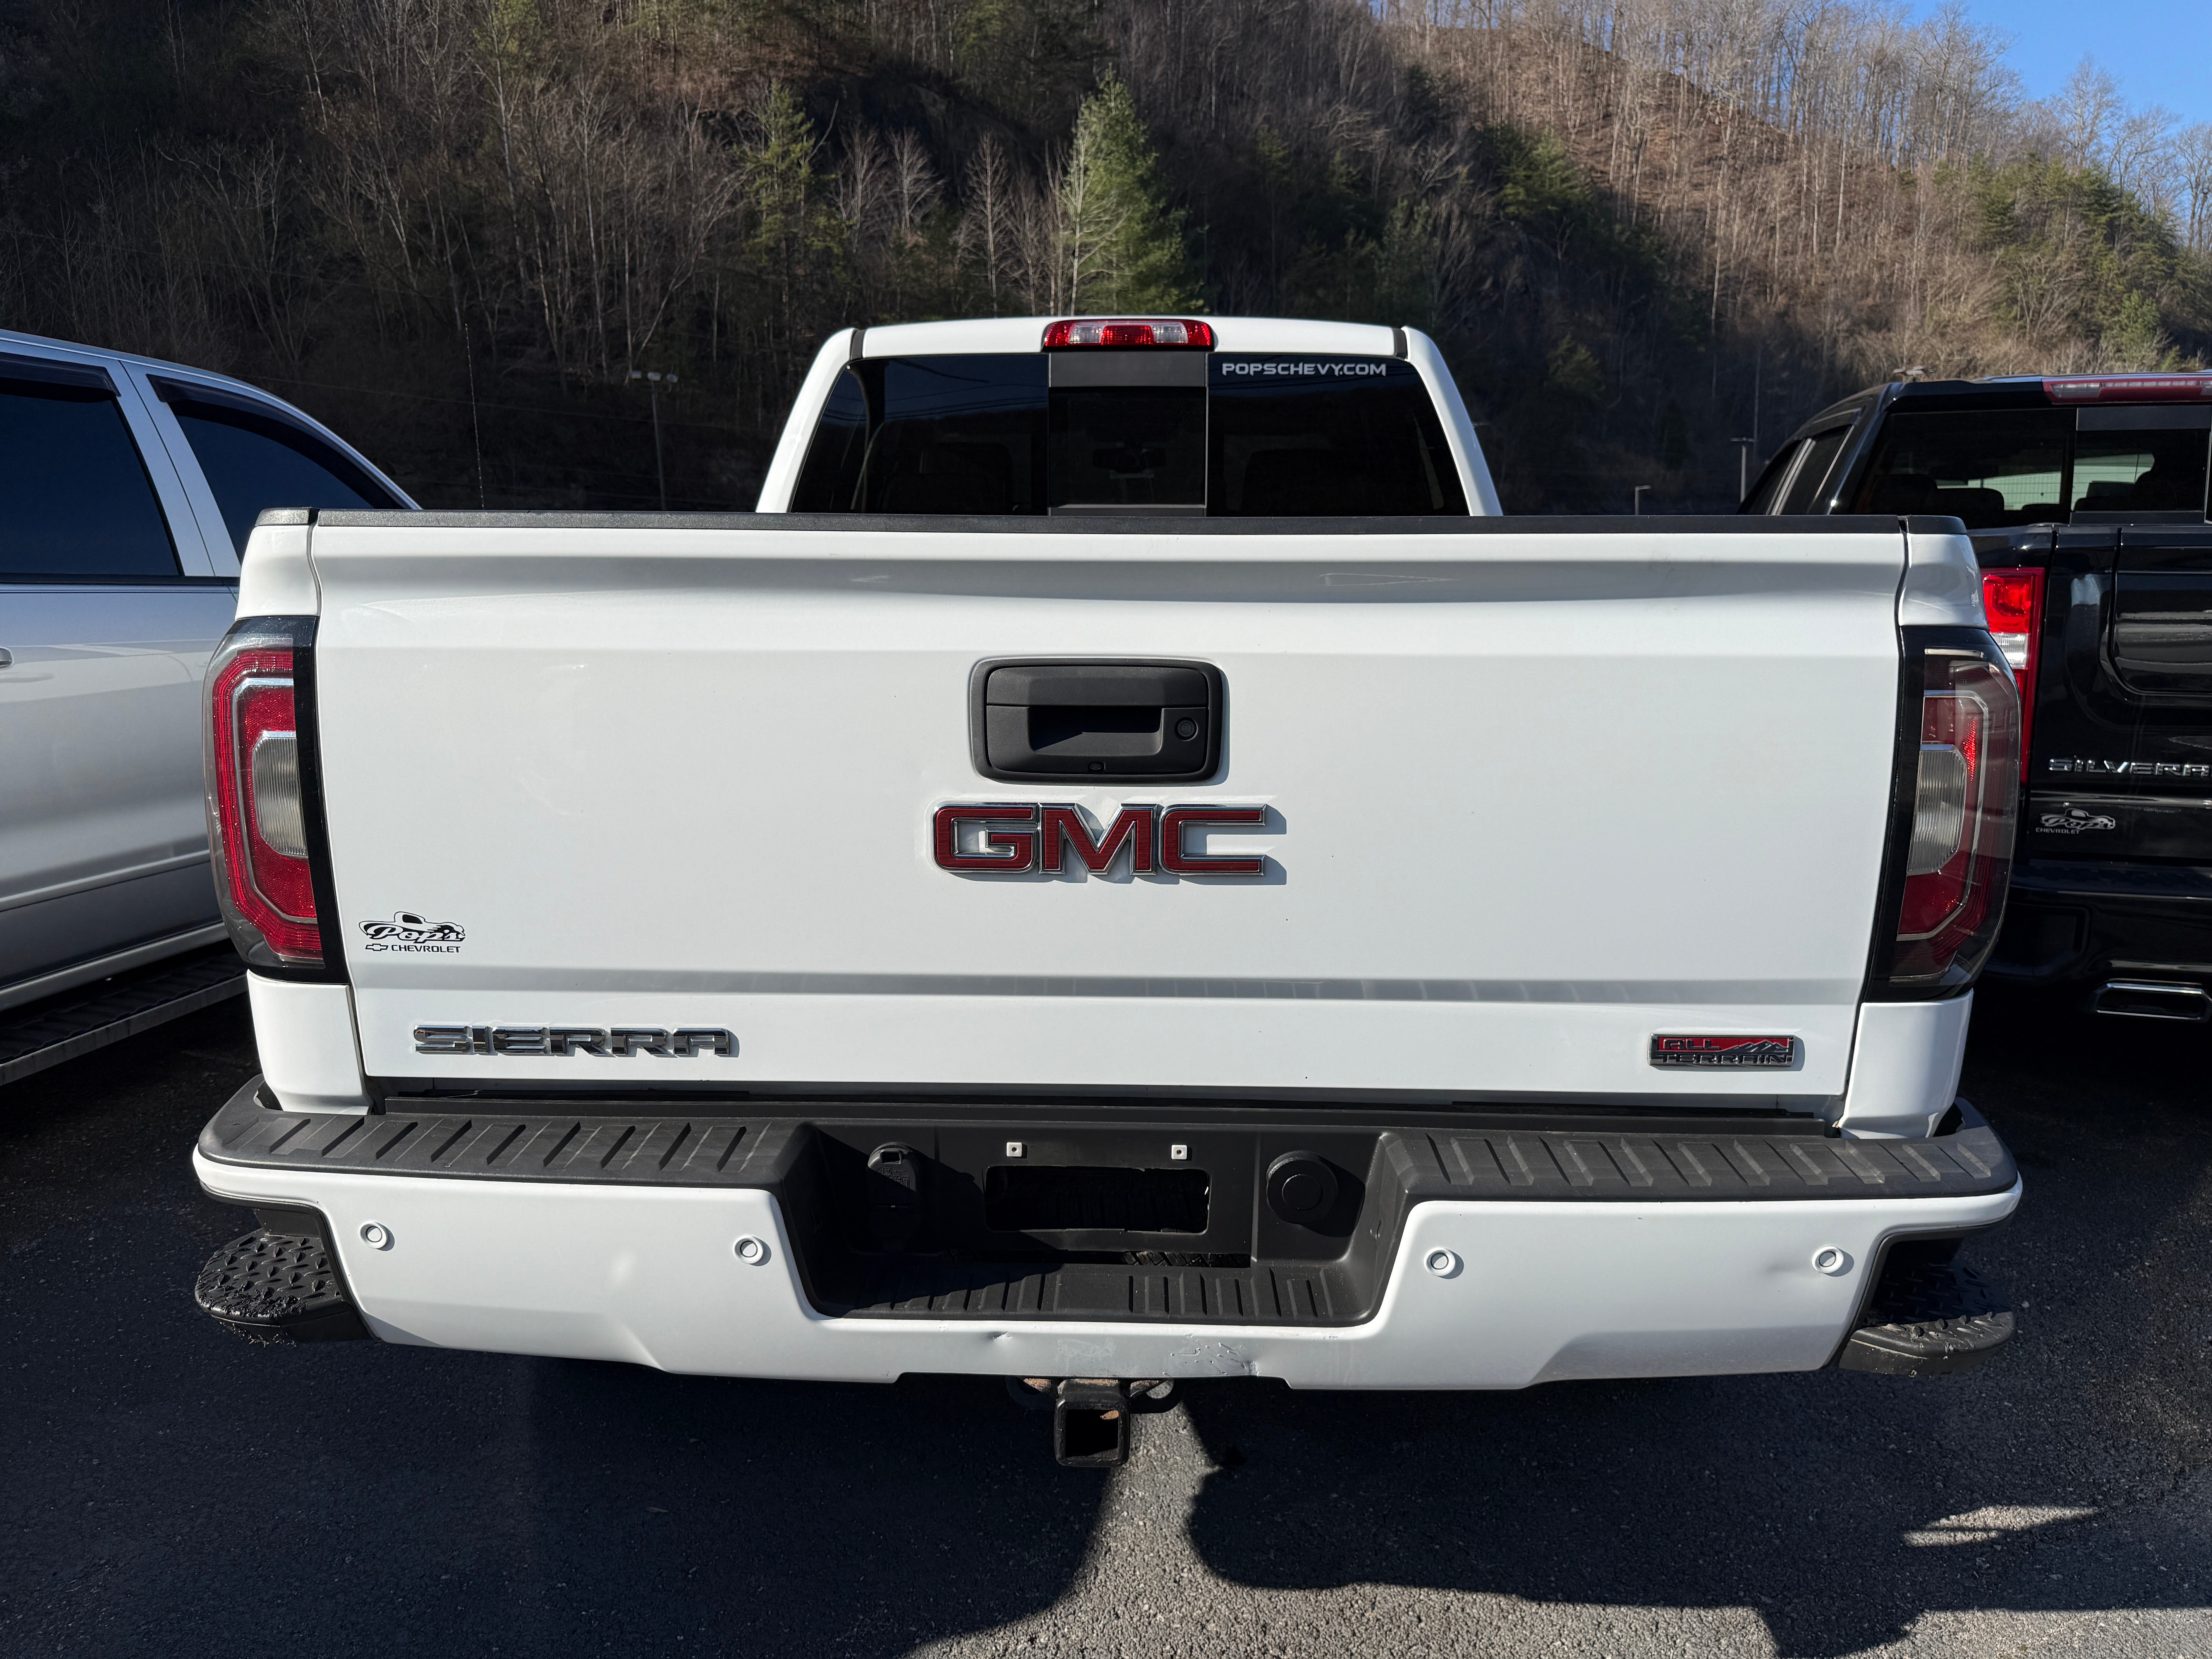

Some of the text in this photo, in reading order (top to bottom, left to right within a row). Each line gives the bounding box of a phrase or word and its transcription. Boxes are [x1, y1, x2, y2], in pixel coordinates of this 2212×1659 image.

[1222, 362, 1386, 376] POPSCHEVY.COM
[934, 802, 1266, 876] GMC
[392, 945, 461, 953] CHEVROLET
[414, 1024, 731, 1056] SIERRA
[1663, 1039, 1720, 1050] ALL
[1656, 1054, 1787, 1065] TERRAIN
